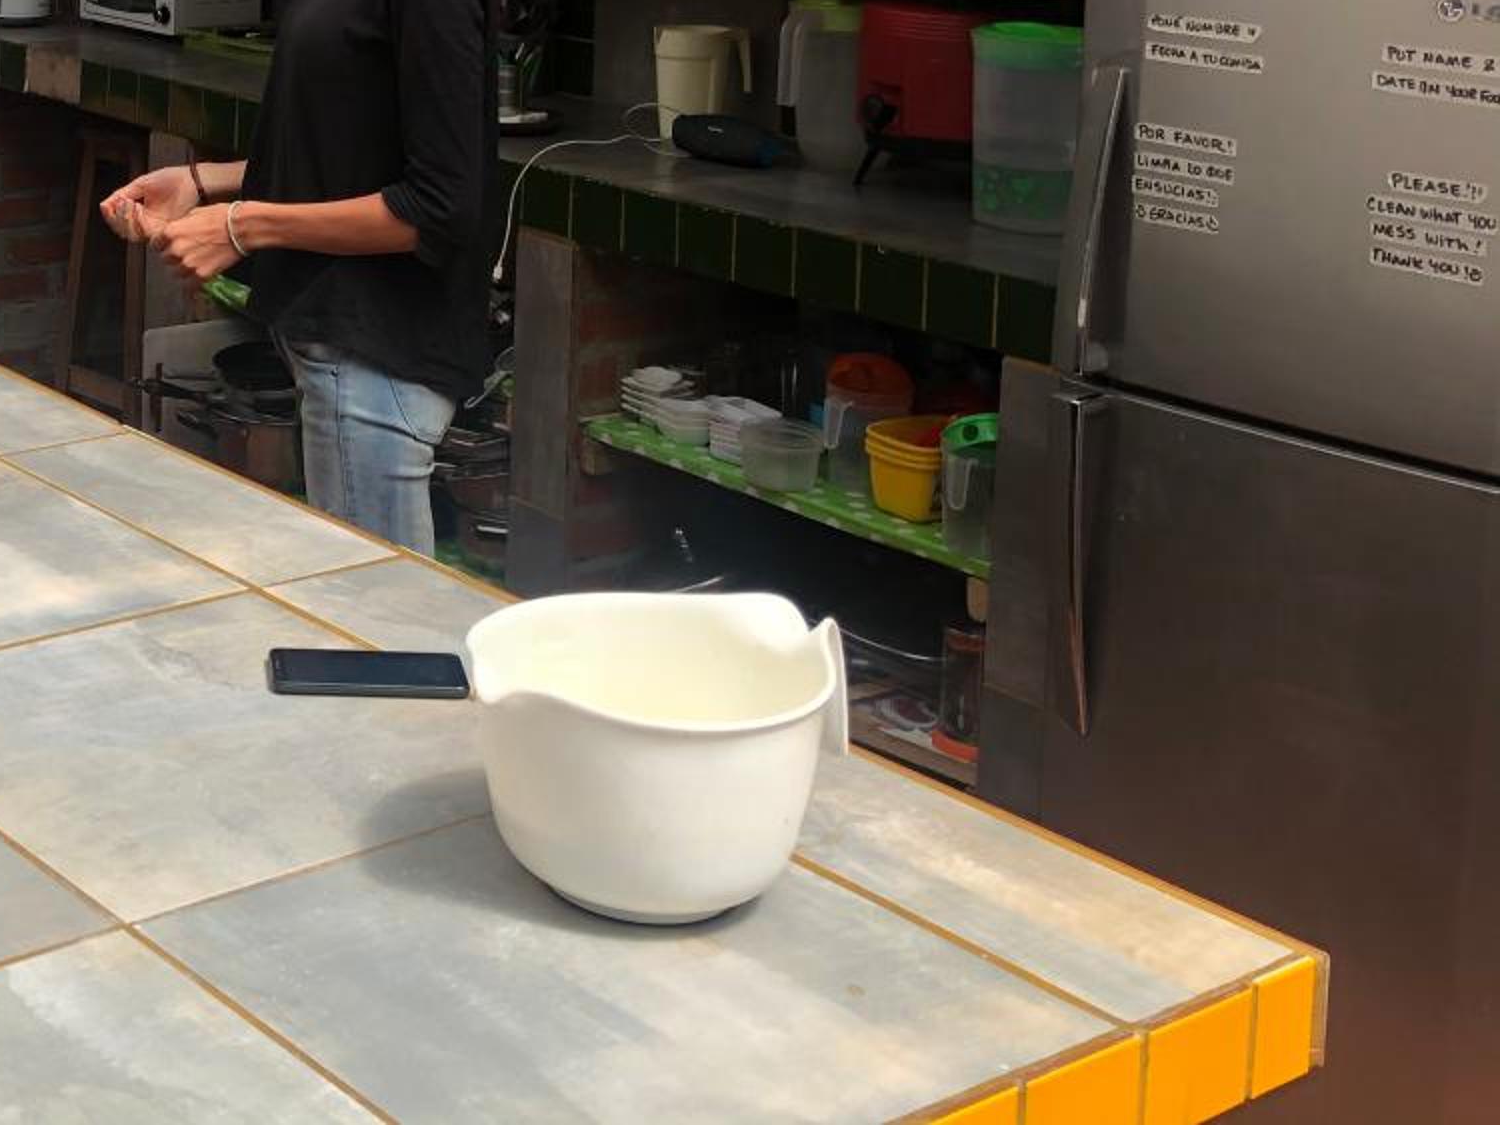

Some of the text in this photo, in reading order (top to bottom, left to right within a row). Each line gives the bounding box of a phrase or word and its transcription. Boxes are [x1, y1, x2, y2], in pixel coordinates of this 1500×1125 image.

[1387, 45, 1416, 61] PUT
[1423, 51, 1473, 68] NAME
[1376, 74, 1415, 90] DATE
[1139, 124, 1165, 140] POR
[1365, 195, 1417, 217] CLEAN
[1373, 223, 1416, 240] MESS
[1372, 247, 1424, 270] THANK
